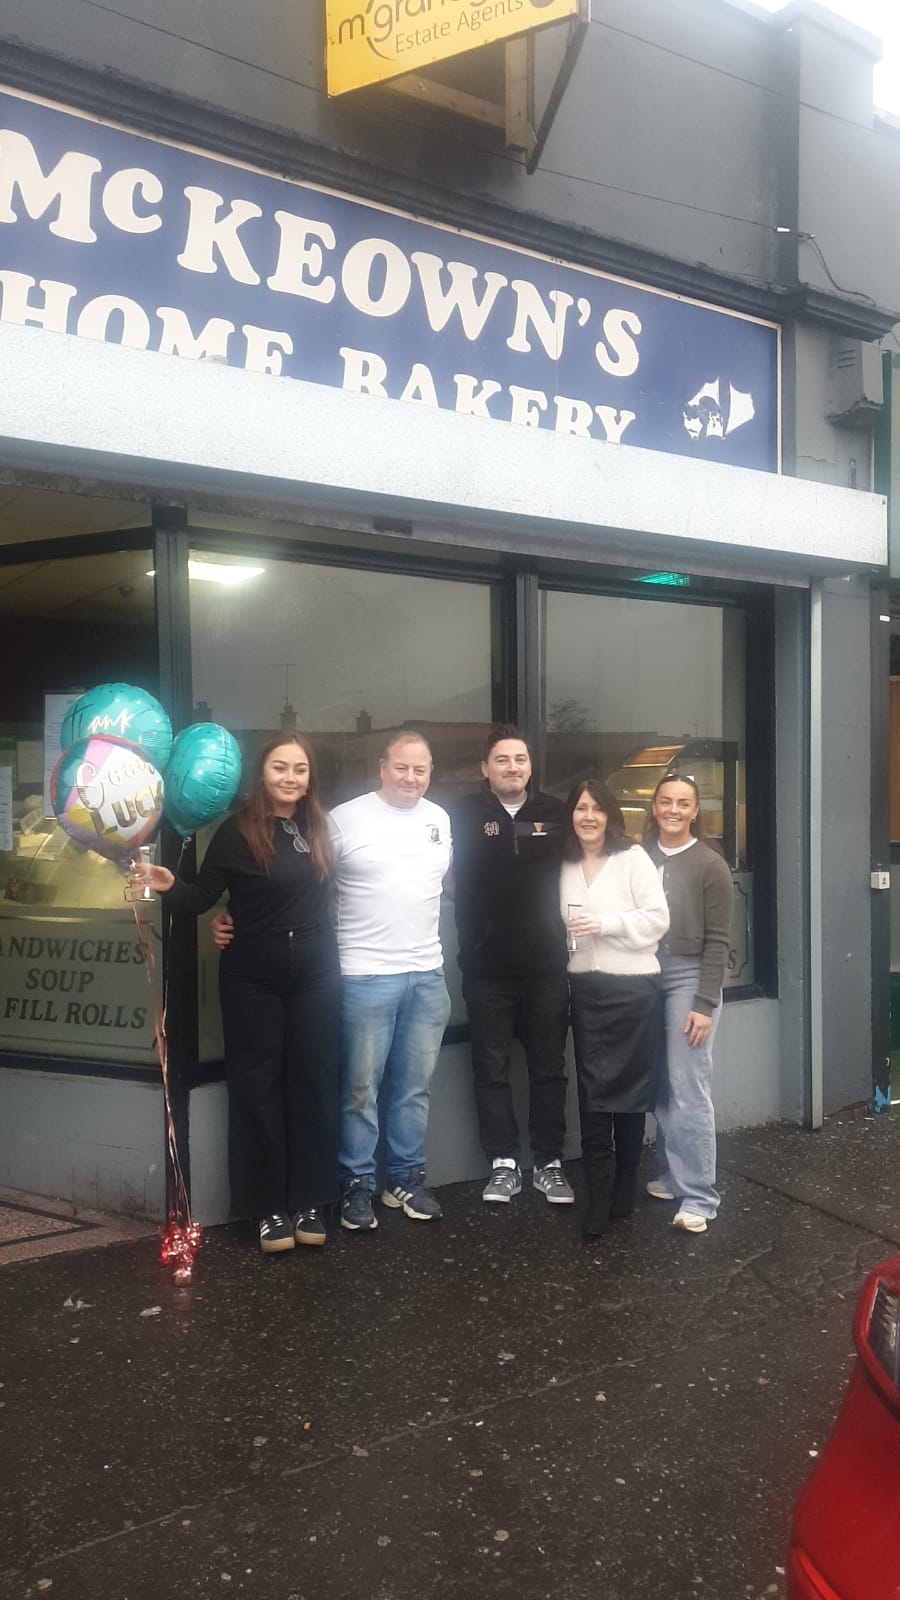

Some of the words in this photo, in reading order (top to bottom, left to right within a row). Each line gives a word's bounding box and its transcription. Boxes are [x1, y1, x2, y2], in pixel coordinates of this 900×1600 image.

[395, 20, 451, 53] Estate
[457, 0, 524, 31] Agents
[0, 270, 294, 377] HOME
[339, 347, 636, 443] BAKERY
[90, 779, 163, 837] LUCK
[0, 936, 149, 965] NDWICHES
[25, 967, 94, 993] SOUP
[3, 996, 59, 1023] FILL
[63, 1002, 147, 1030] ROLLS
